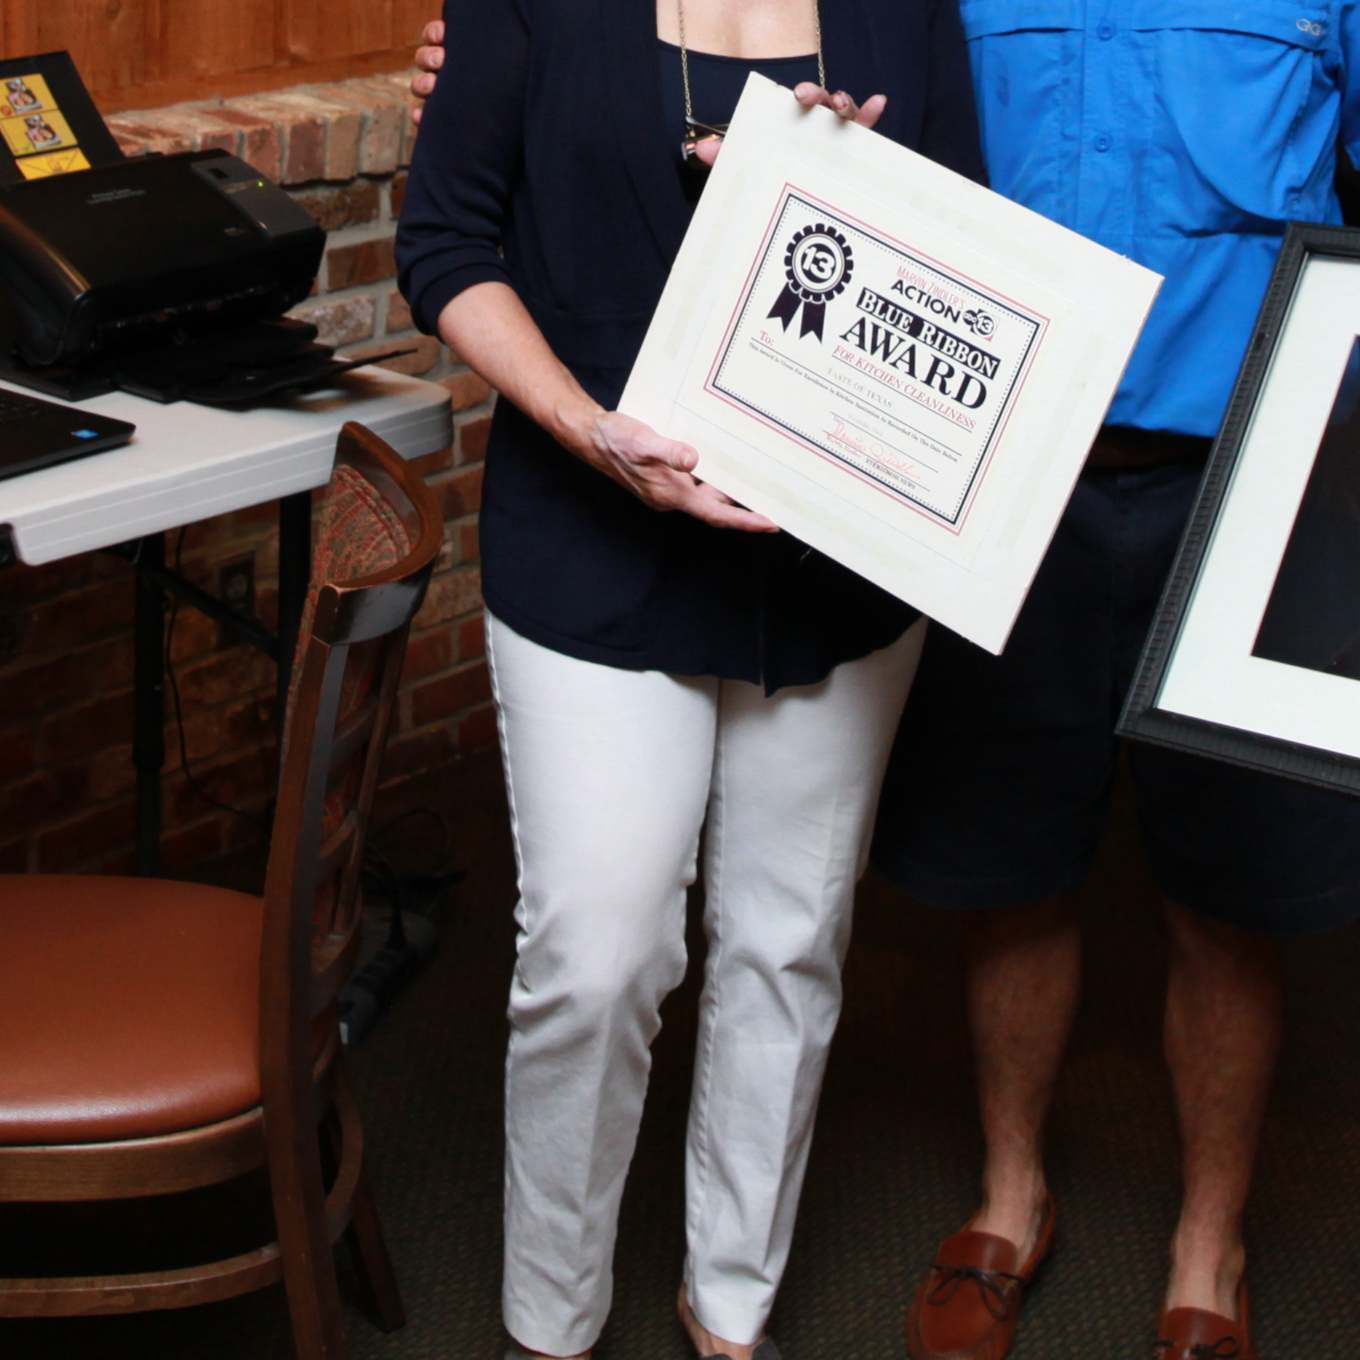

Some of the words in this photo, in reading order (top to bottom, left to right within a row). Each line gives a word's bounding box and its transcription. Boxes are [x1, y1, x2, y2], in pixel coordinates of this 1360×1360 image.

[798, 243, 837, 283] 13
[759, 329, 774, 346] To:
[857, 288, 915, 333] BLUE
[916, 319, 999, 378] RIBBON
[890, 279, 960, 323] ACTION
[976, 315, 991, 333] 13
[832, 344, 855, 362] FOR
[854, 356, 900, 388] KITCHEN
[903, 383, 976, 429] CLEANLINESS
[839, 316, 986, 409] AWARD
